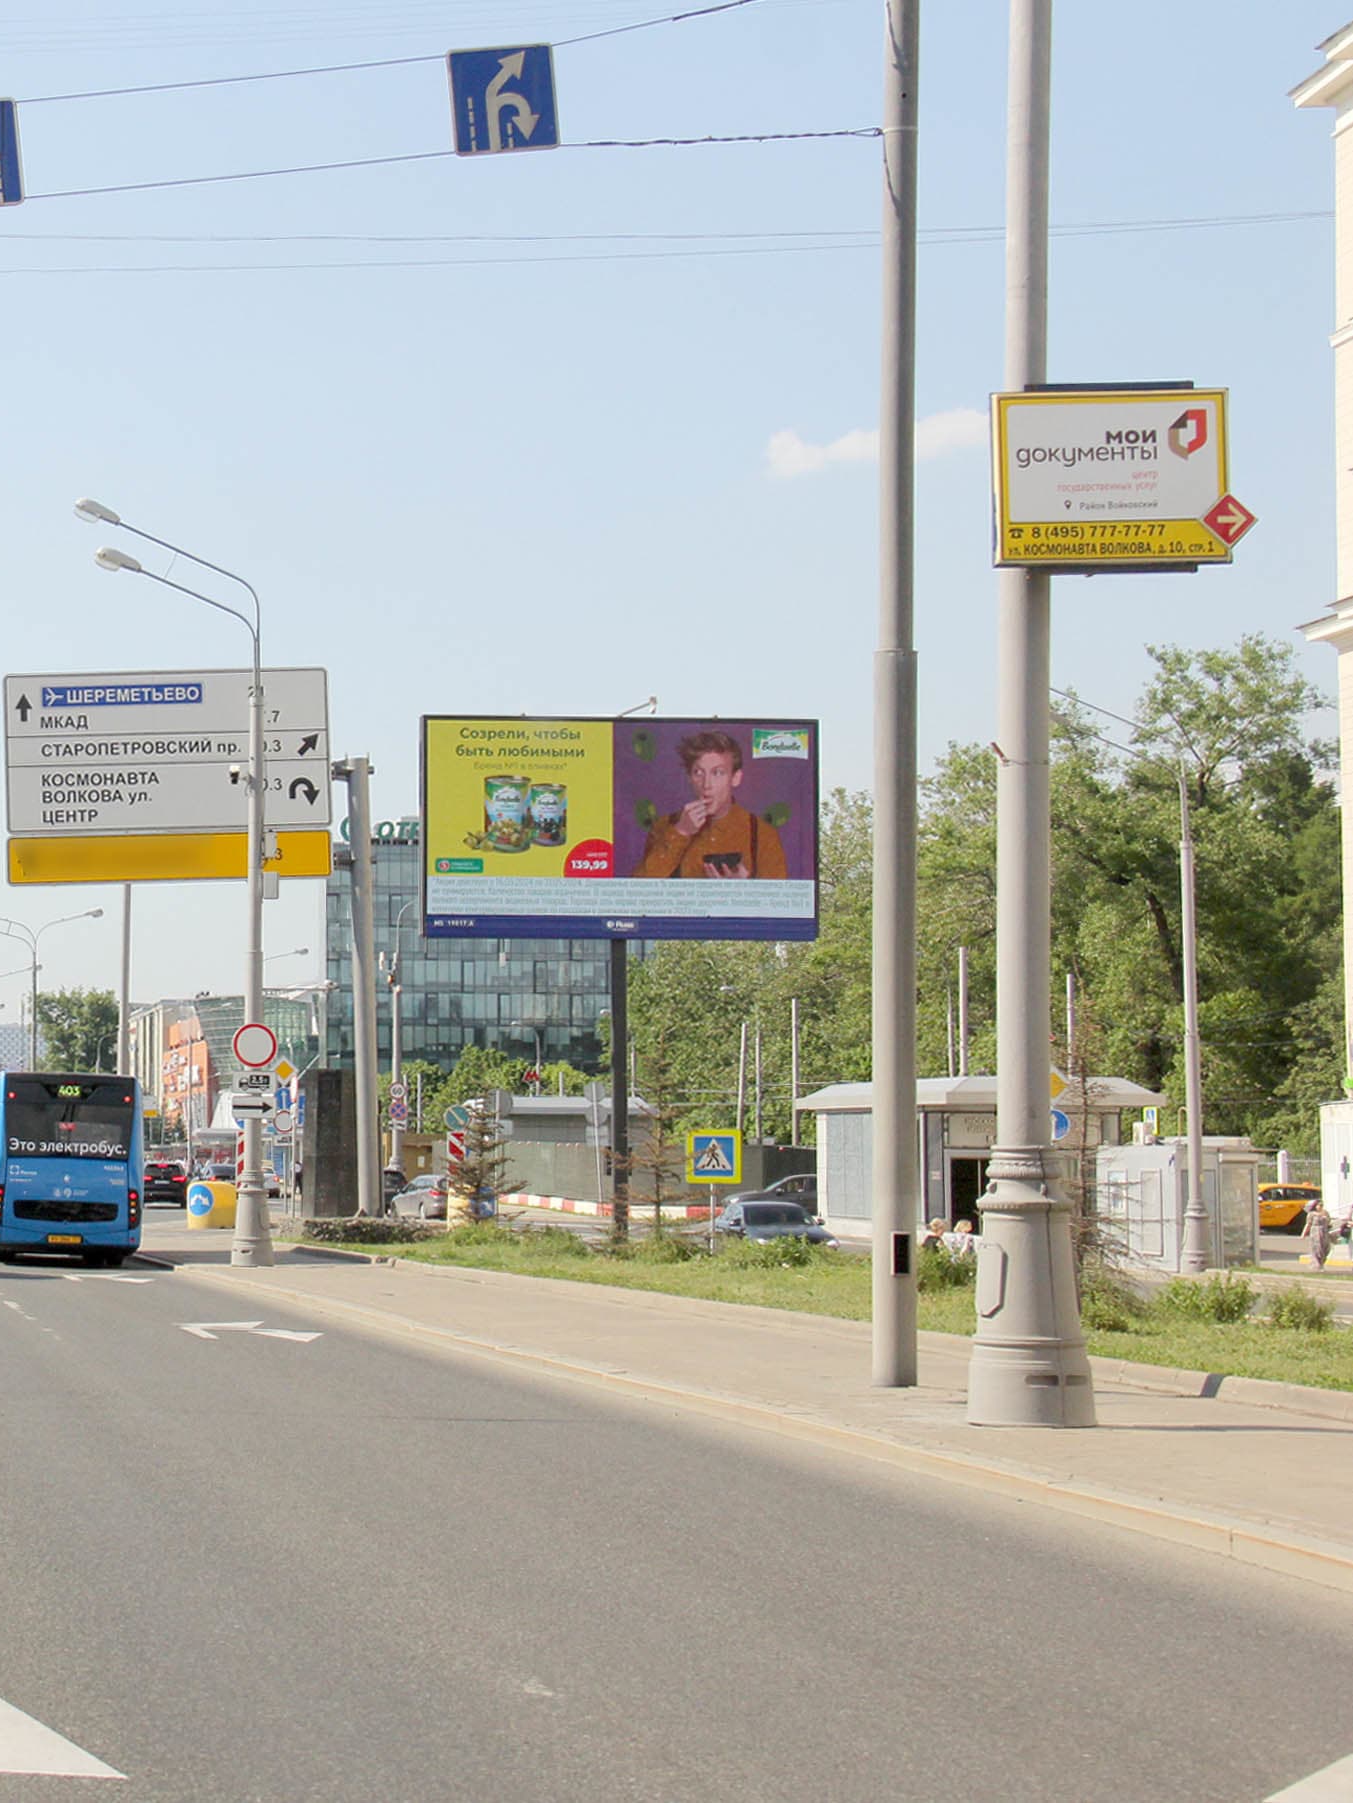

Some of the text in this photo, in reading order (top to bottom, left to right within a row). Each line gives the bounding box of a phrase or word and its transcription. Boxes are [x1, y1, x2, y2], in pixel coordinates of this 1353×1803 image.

[1105, 430, 1157, 445] мои
[1016, 445, 1158, 468] документы
[1031, 523, 1166, 540] 8 (495) 777-77-77
[1023, 543, 1097, 556] КОСМОНАВТА
[1100, 541, 1156, 555] ВОЛКОВА,
[66, 686, 200, 704] ШЕРЕМЕТЬЕВО
[40, 715, 88, 730] МКАД
[459, 727, 581, 741] Созрели, чтобы
[41, 738, 212, 757] СТАРОПЕТРОВСКИЙ
[217, 742, 241, 756] пр.
[455, 744, 585, 758] быть любимыми
[41, 771, 160, 787] КОСМОНАВТА
[42, 789, 152, 806] ВОЛКОВА ул.
[42, 809, 98, 826] ЦЕНТР
[58, 1085, 81, 1097] 403
[8, 1137, 127, 1157] Это электробус.
